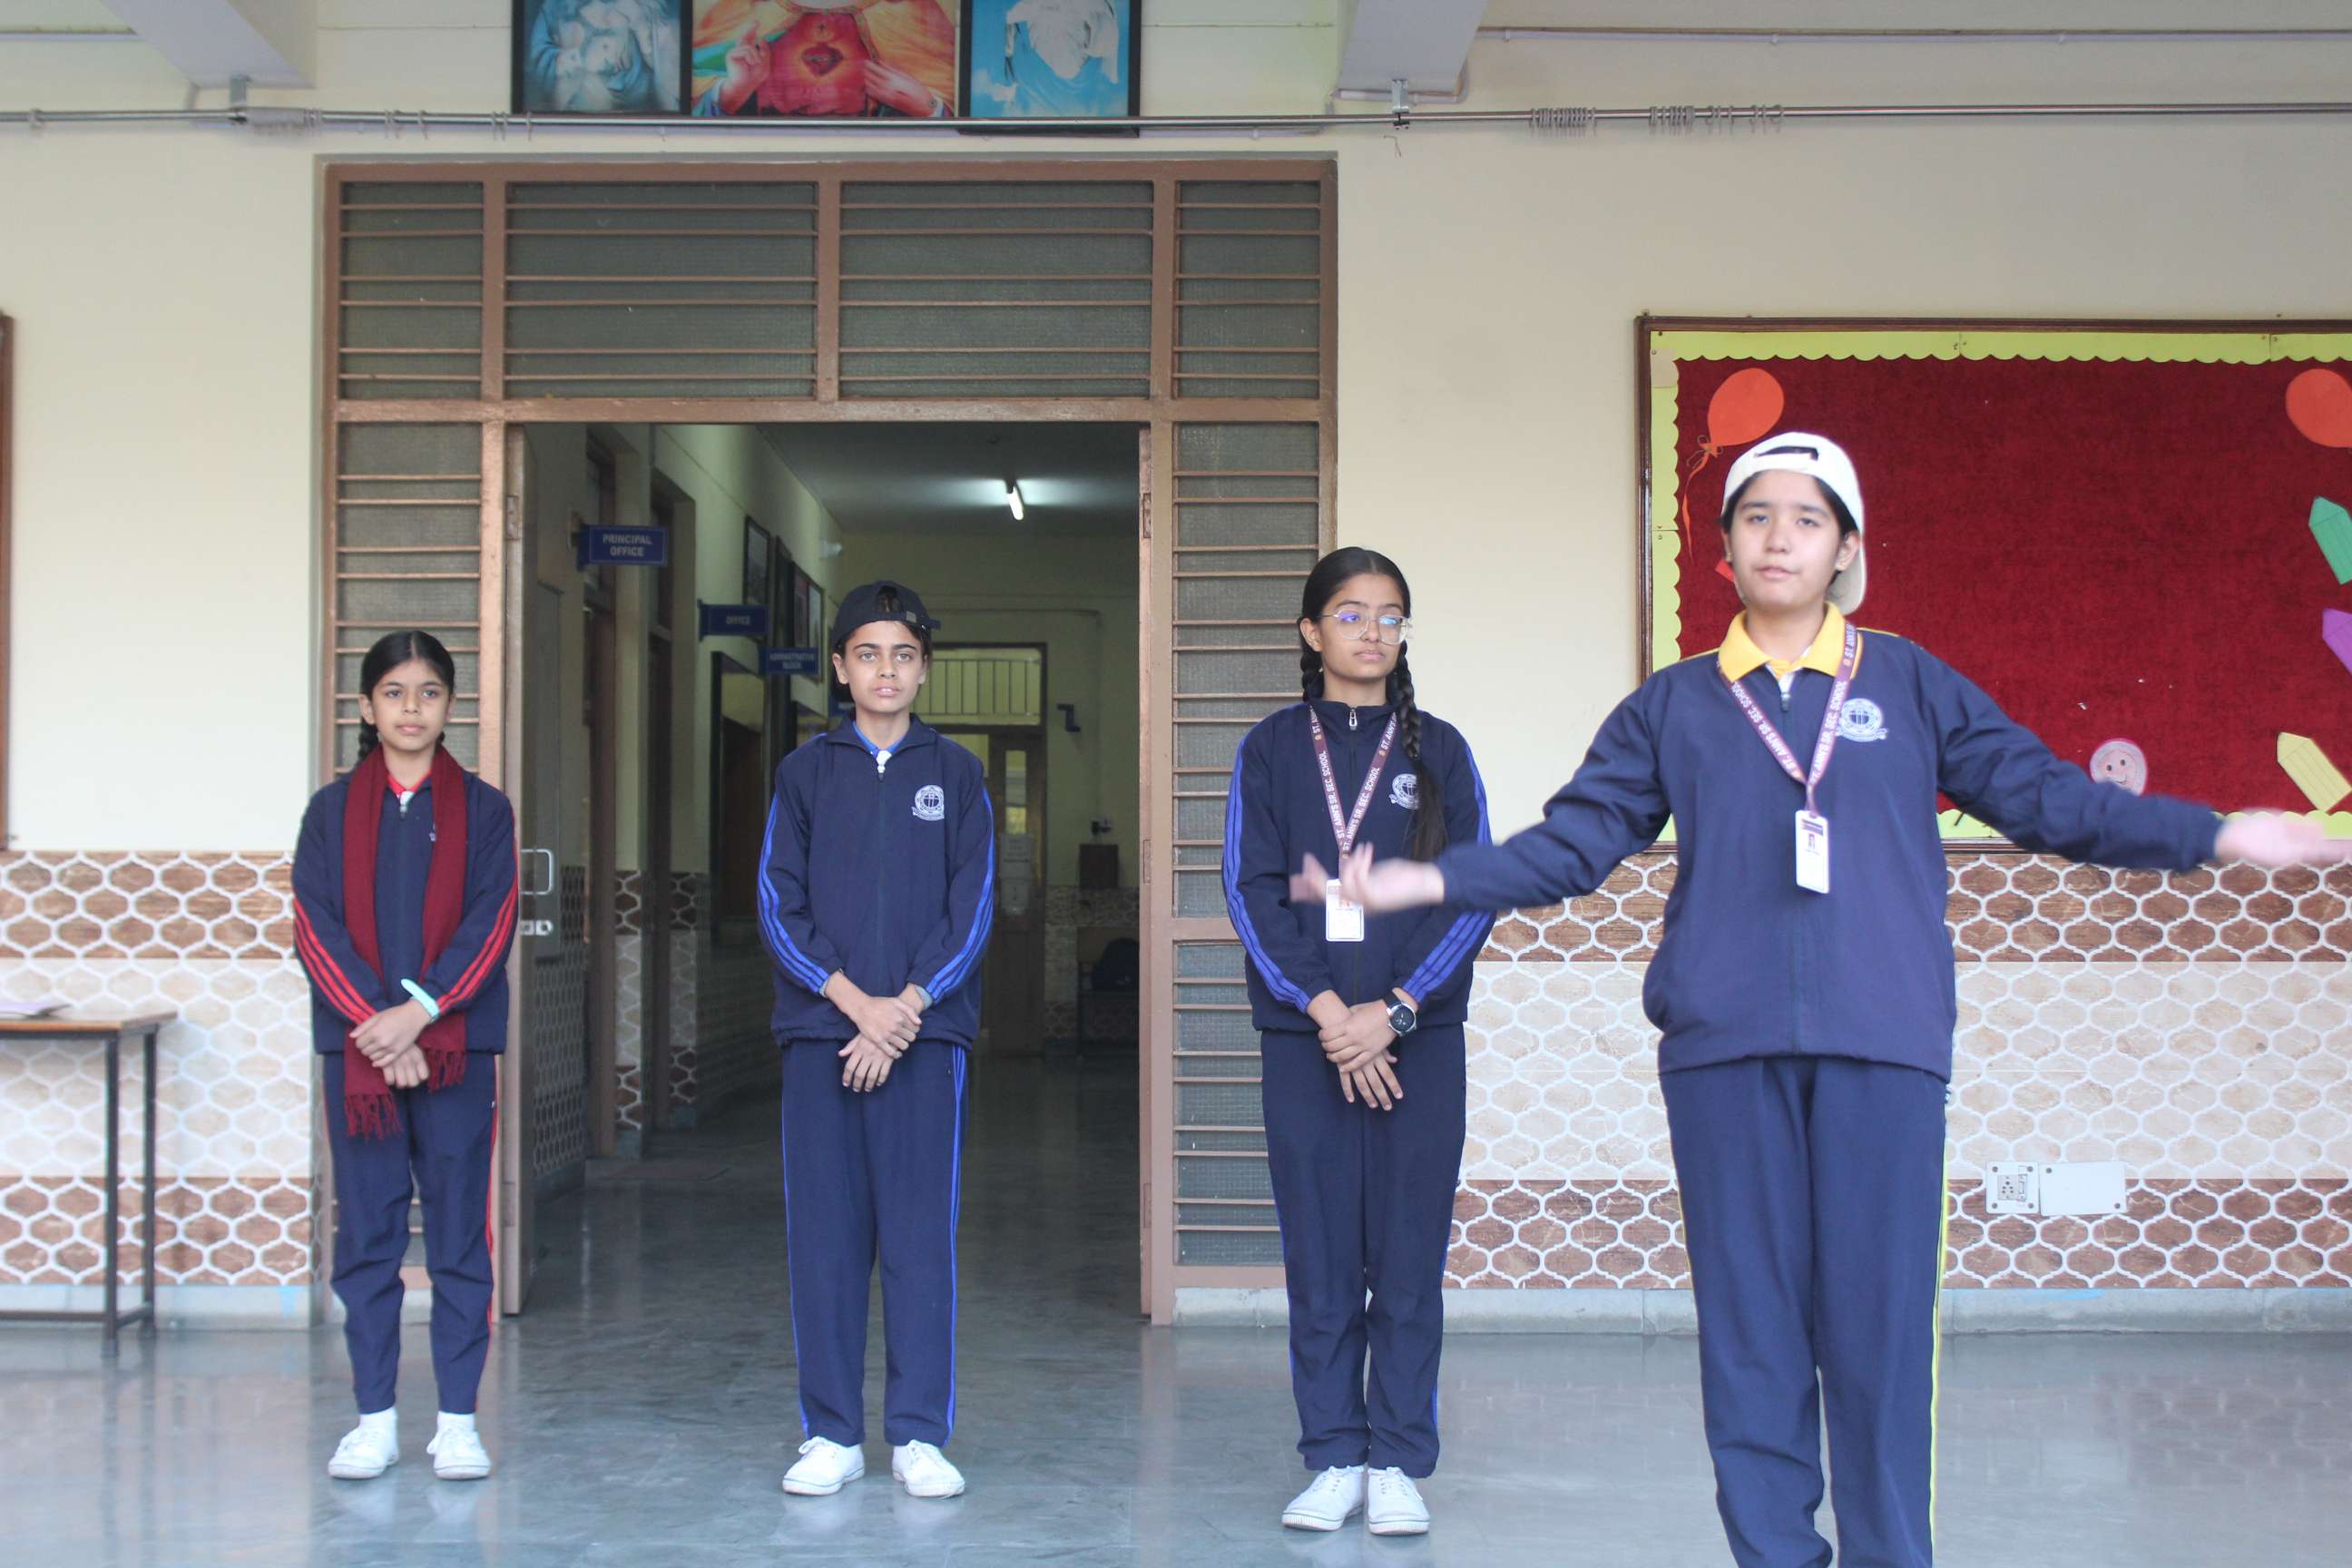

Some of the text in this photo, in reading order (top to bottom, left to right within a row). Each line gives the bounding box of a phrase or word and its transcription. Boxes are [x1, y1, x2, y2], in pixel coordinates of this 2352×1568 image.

[603, 534, 653, 545] PRINCIPAL
[610, 545, 644, 557] OFFICE
[1318, 750, 1330, 776] SCHOOL
[1325, 777, 1336, 792] SEC.
[1364, 767, 1380, 792] SCHOOL
[1337, 828, 1345, 839] ST.
